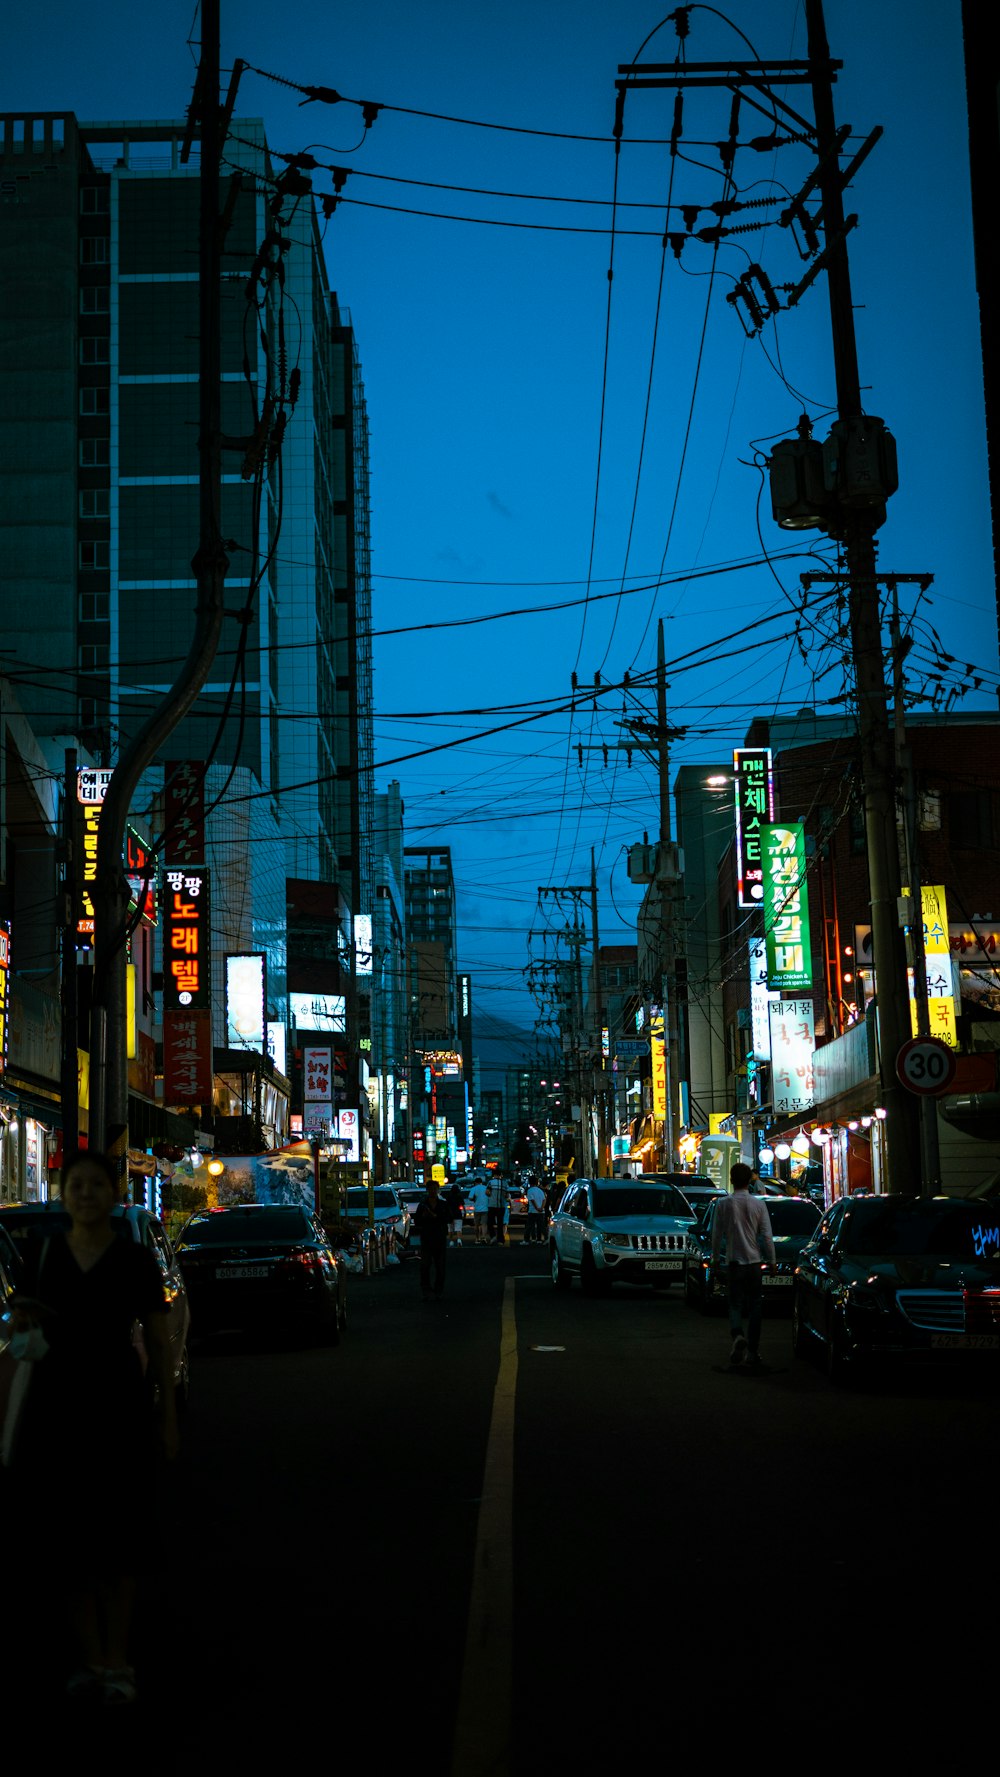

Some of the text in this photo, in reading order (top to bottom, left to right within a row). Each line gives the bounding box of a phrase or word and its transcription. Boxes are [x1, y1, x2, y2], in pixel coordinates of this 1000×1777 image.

[743, 760, 766, 860] 맨체스터
[167, 872, 202, 896] 팡팡
[770, 857, 804, 972] 생생갈비
[170, 893, 199, 991] 노래텔
[772, 1001, 812, 1015] 돼지꿈
[909, 1052, 944, 1080] 30
